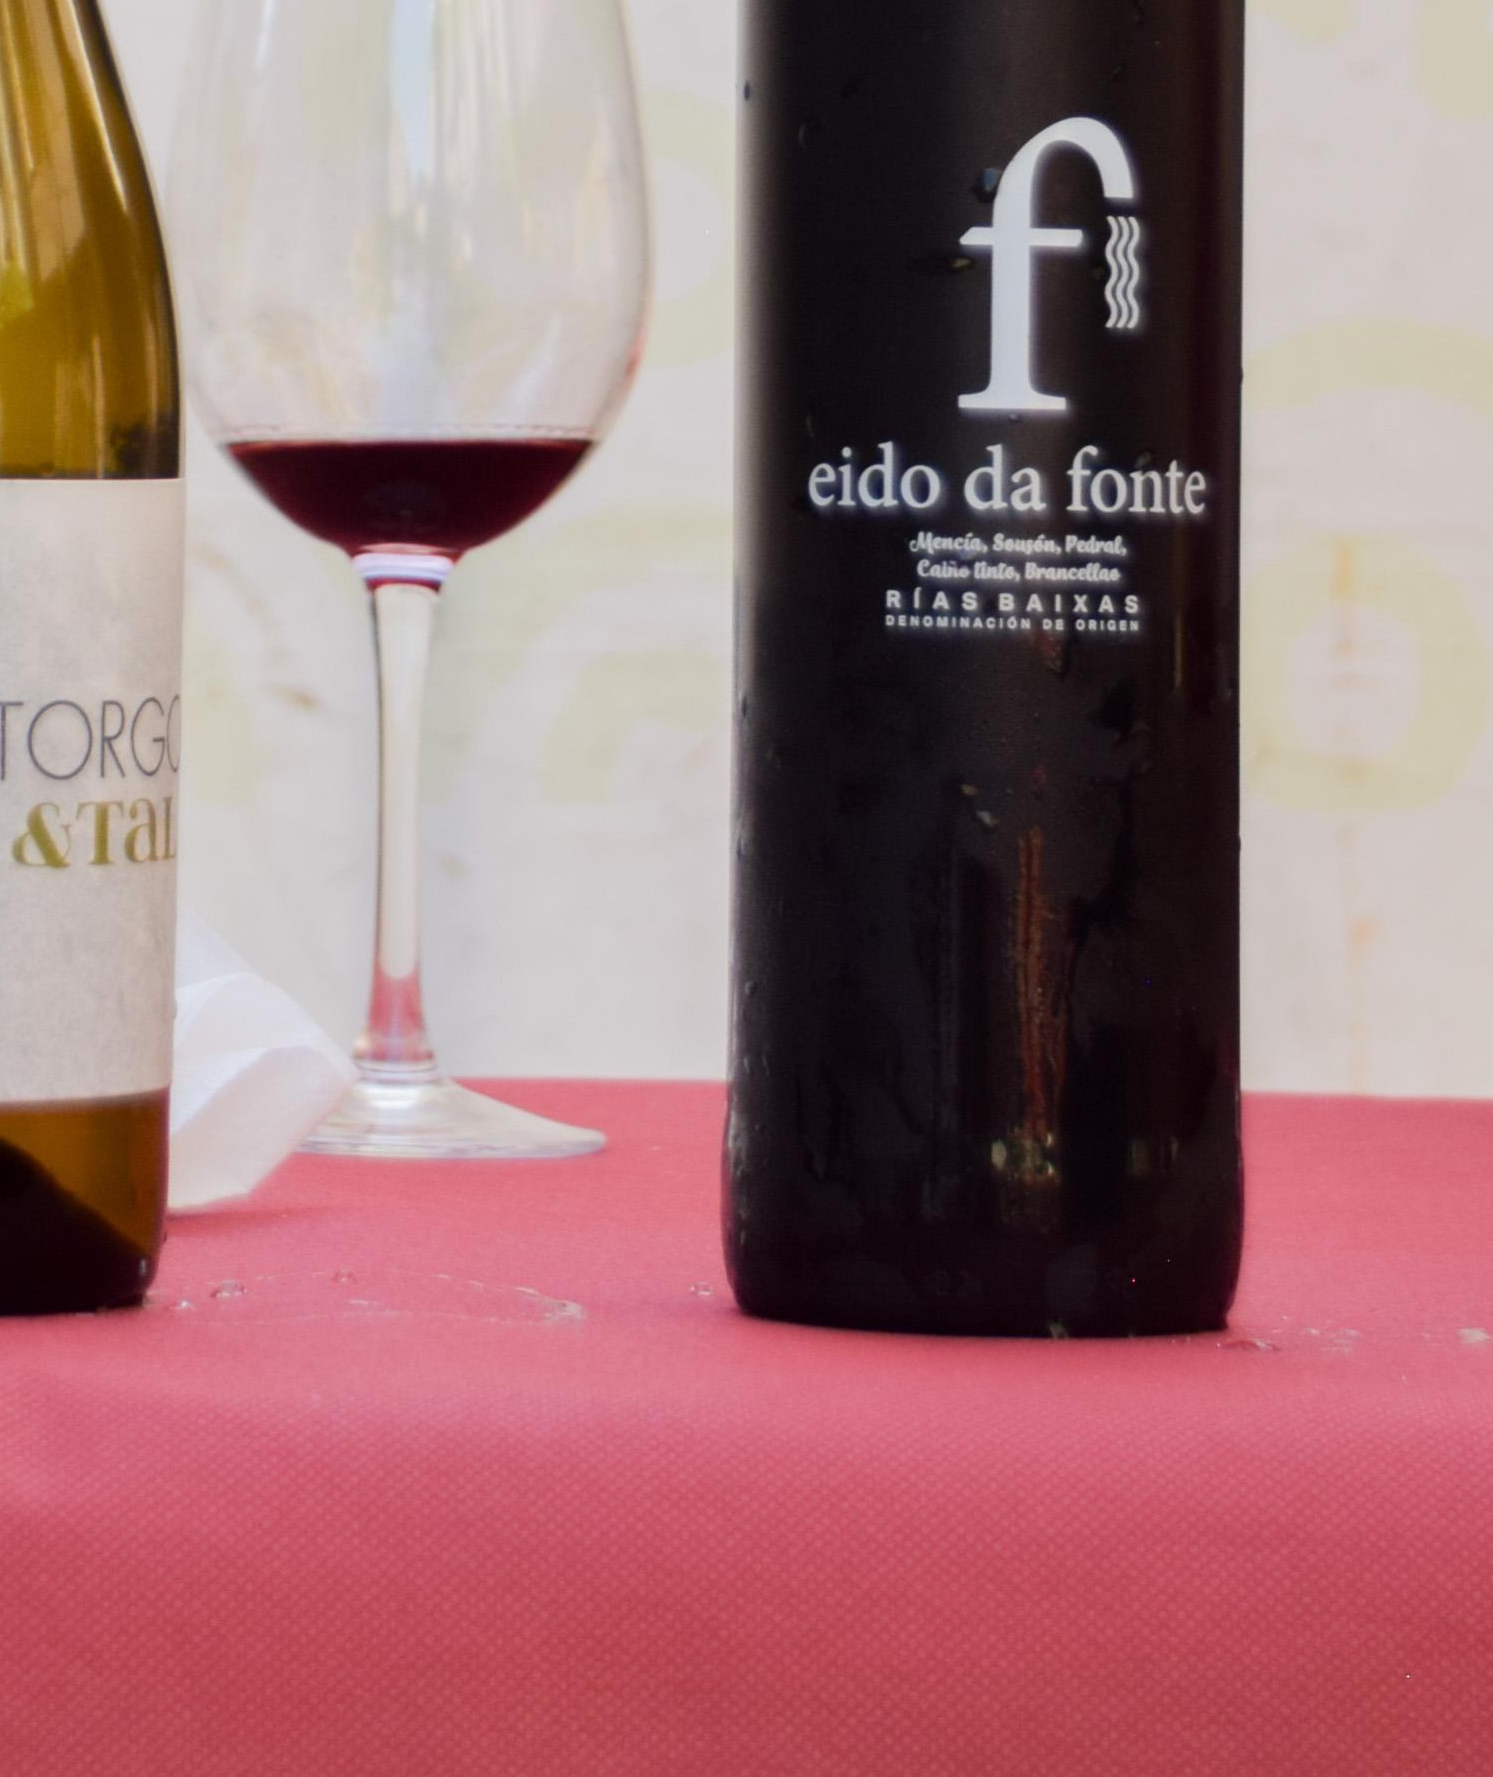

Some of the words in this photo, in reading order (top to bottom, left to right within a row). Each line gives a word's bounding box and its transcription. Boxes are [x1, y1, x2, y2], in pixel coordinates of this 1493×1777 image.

[807, 441, 942, 512] eido
[964, 443, 1047, 513] da
[1066, 444, 1207, 515] fonte
[885, 586, 978, 612] RÍAS
[998, 592, 1140, 614] BAIXAS
[885, 614, 1032, 630] DENOMINACIÓN
[1042, 618, 1065, 631] DE
[1075, 619, 1140, 632] ORIGEN
